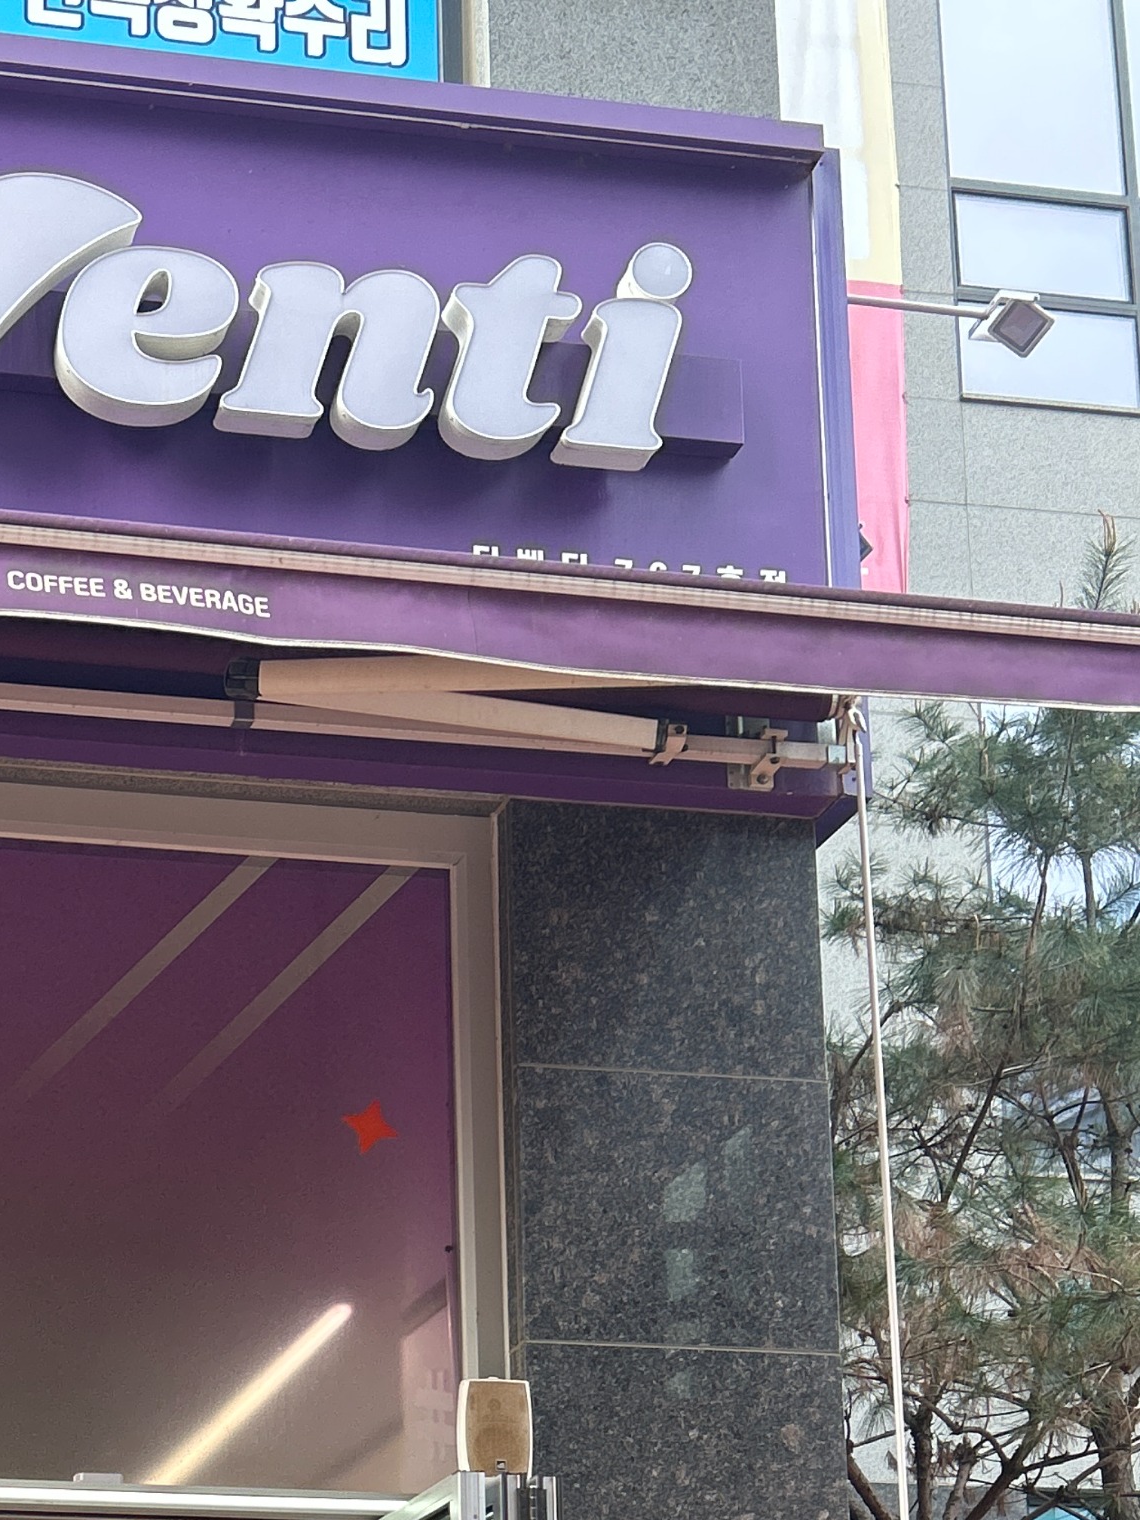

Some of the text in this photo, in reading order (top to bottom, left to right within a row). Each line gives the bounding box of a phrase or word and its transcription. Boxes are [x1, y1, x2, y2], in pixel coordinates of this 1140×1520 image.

[6, 570, 272, 619] COFFEE & BEVERAGE
